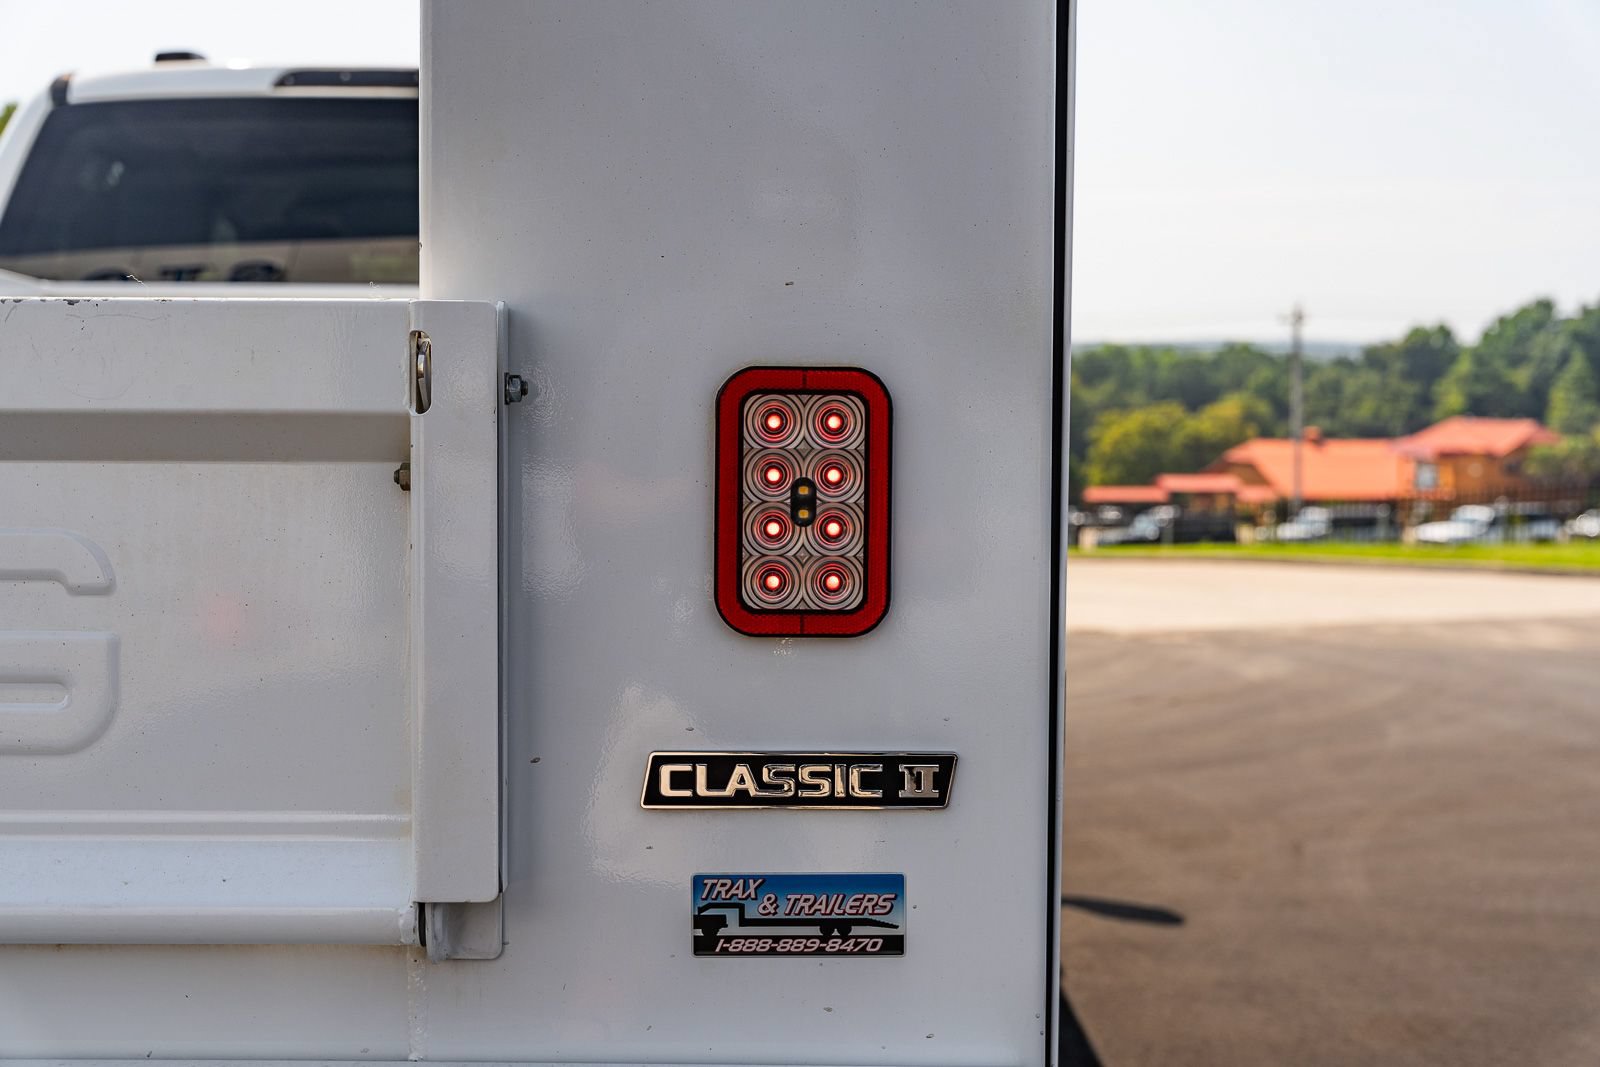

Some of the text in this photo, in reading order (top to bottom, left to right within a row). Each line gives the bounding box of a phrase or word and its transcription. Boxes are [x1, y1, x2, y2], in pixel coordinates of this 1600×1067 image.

[658, 763, 940, 798] CLASSIC II
[700, 878, 763, 900] TRAX
[757, 893, 896, 916] & TRAILERS
[714, 937, 884, 954] 1-888-889-8470
